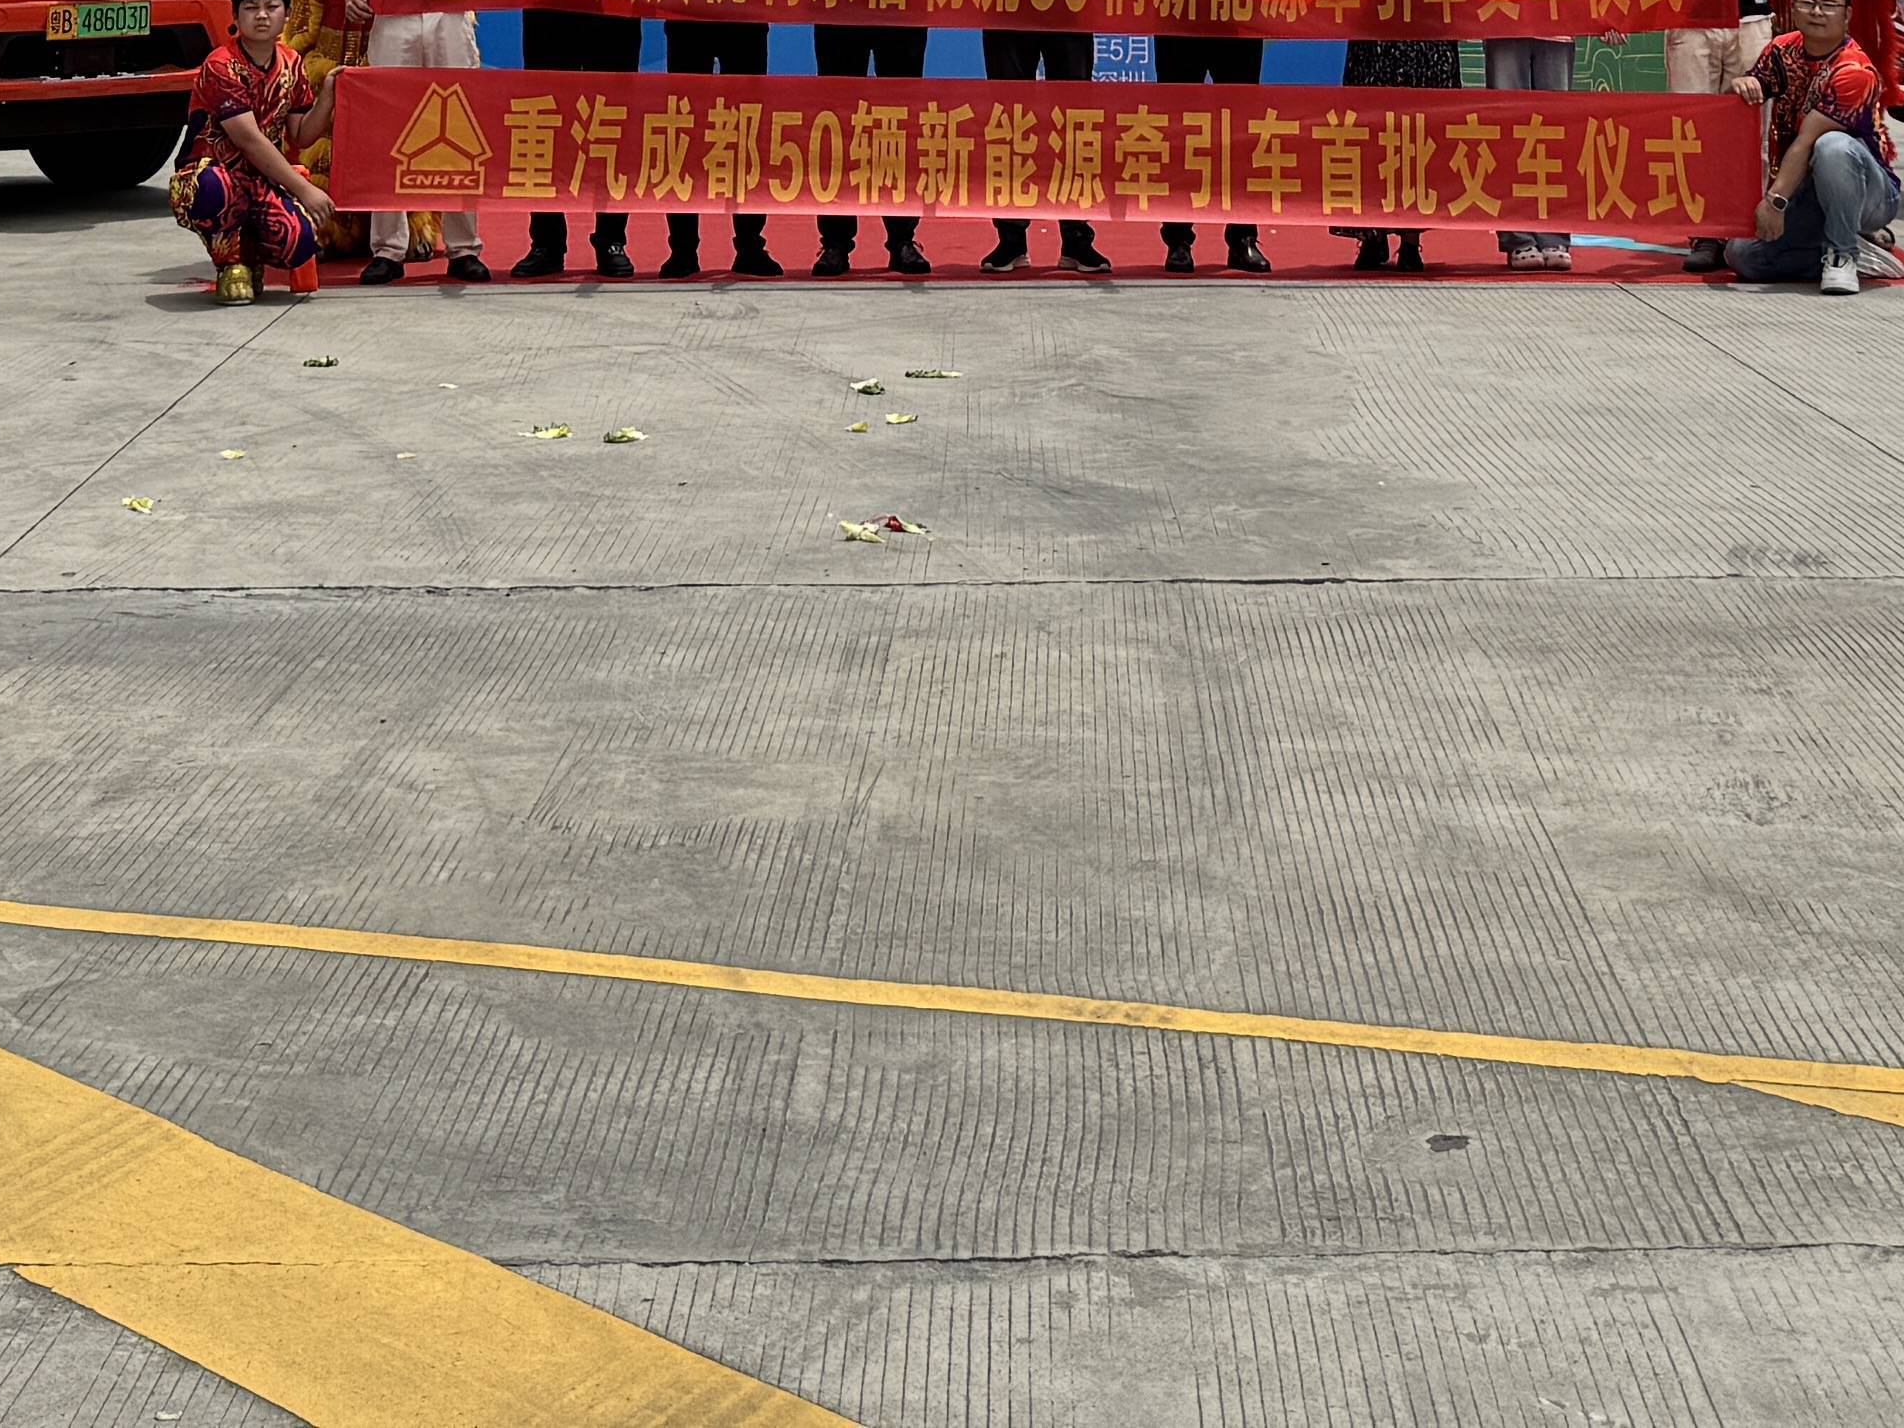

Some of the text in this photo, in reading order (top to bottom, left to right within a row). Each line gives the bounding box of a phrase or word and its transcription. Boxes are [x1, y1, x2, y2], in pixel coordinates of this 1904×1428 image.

[402, 174, 478, 187] CNHTC
[502, 94, 1705, 224] 重汽成都50辆新能源牵引车首批交车仪式
